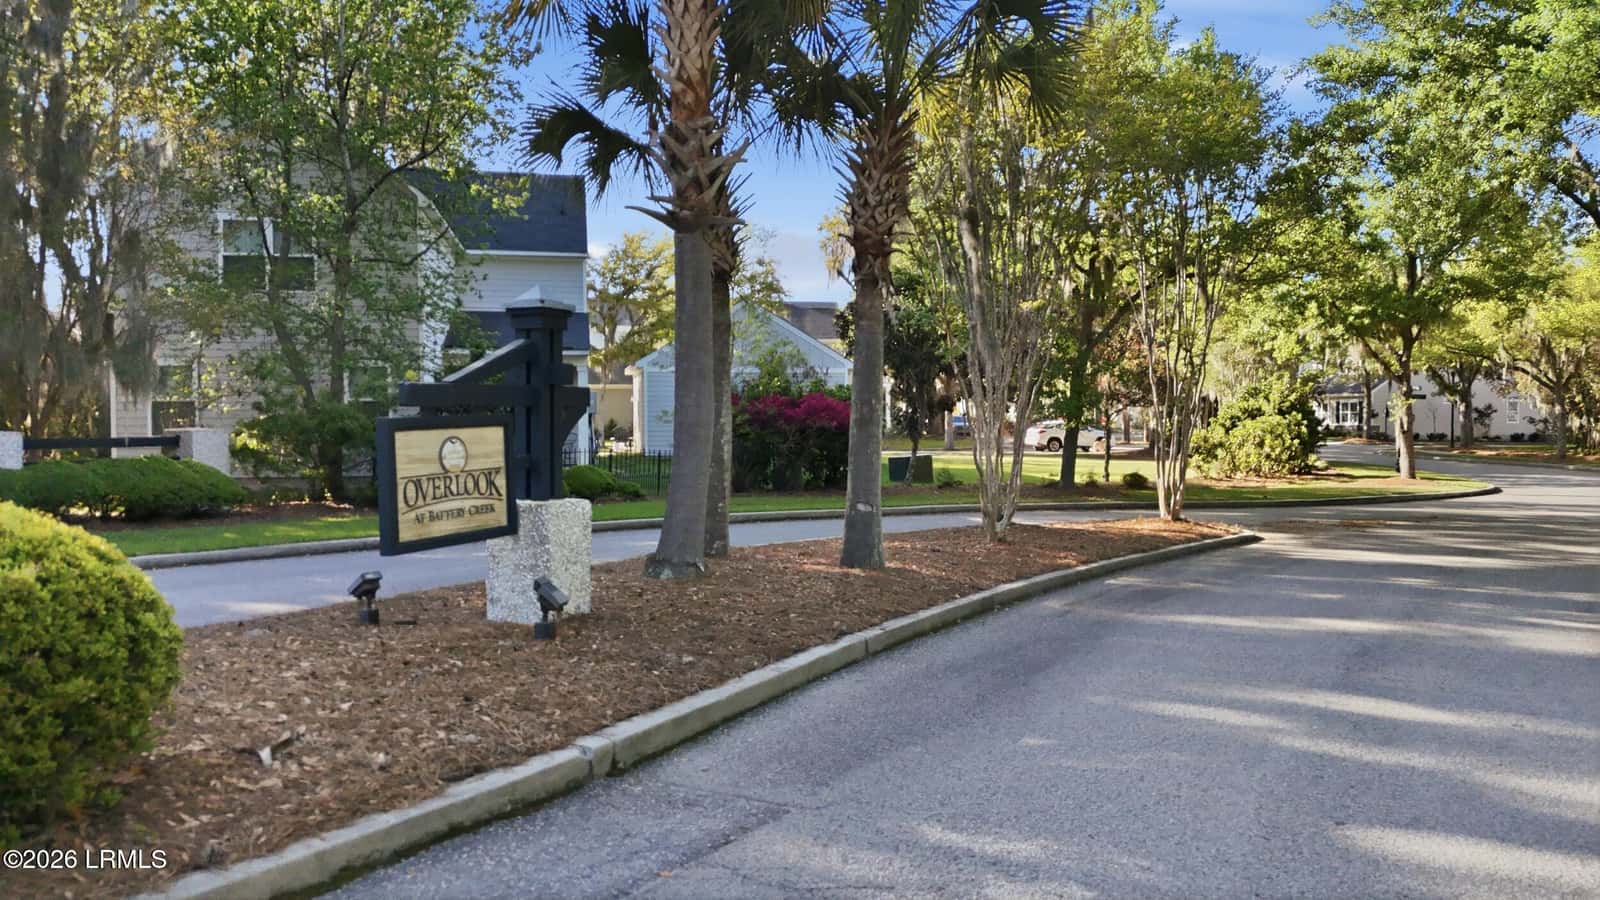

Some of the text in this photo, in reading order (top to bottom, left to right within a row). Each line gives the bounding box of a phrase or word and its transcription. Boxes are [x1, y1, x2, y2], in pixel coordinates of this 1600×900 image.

[403, 471, 503, 508] OVERLOOK
[428, 507, 465, 522] BATTERY
[468, 503, 496, 516] CREEK
